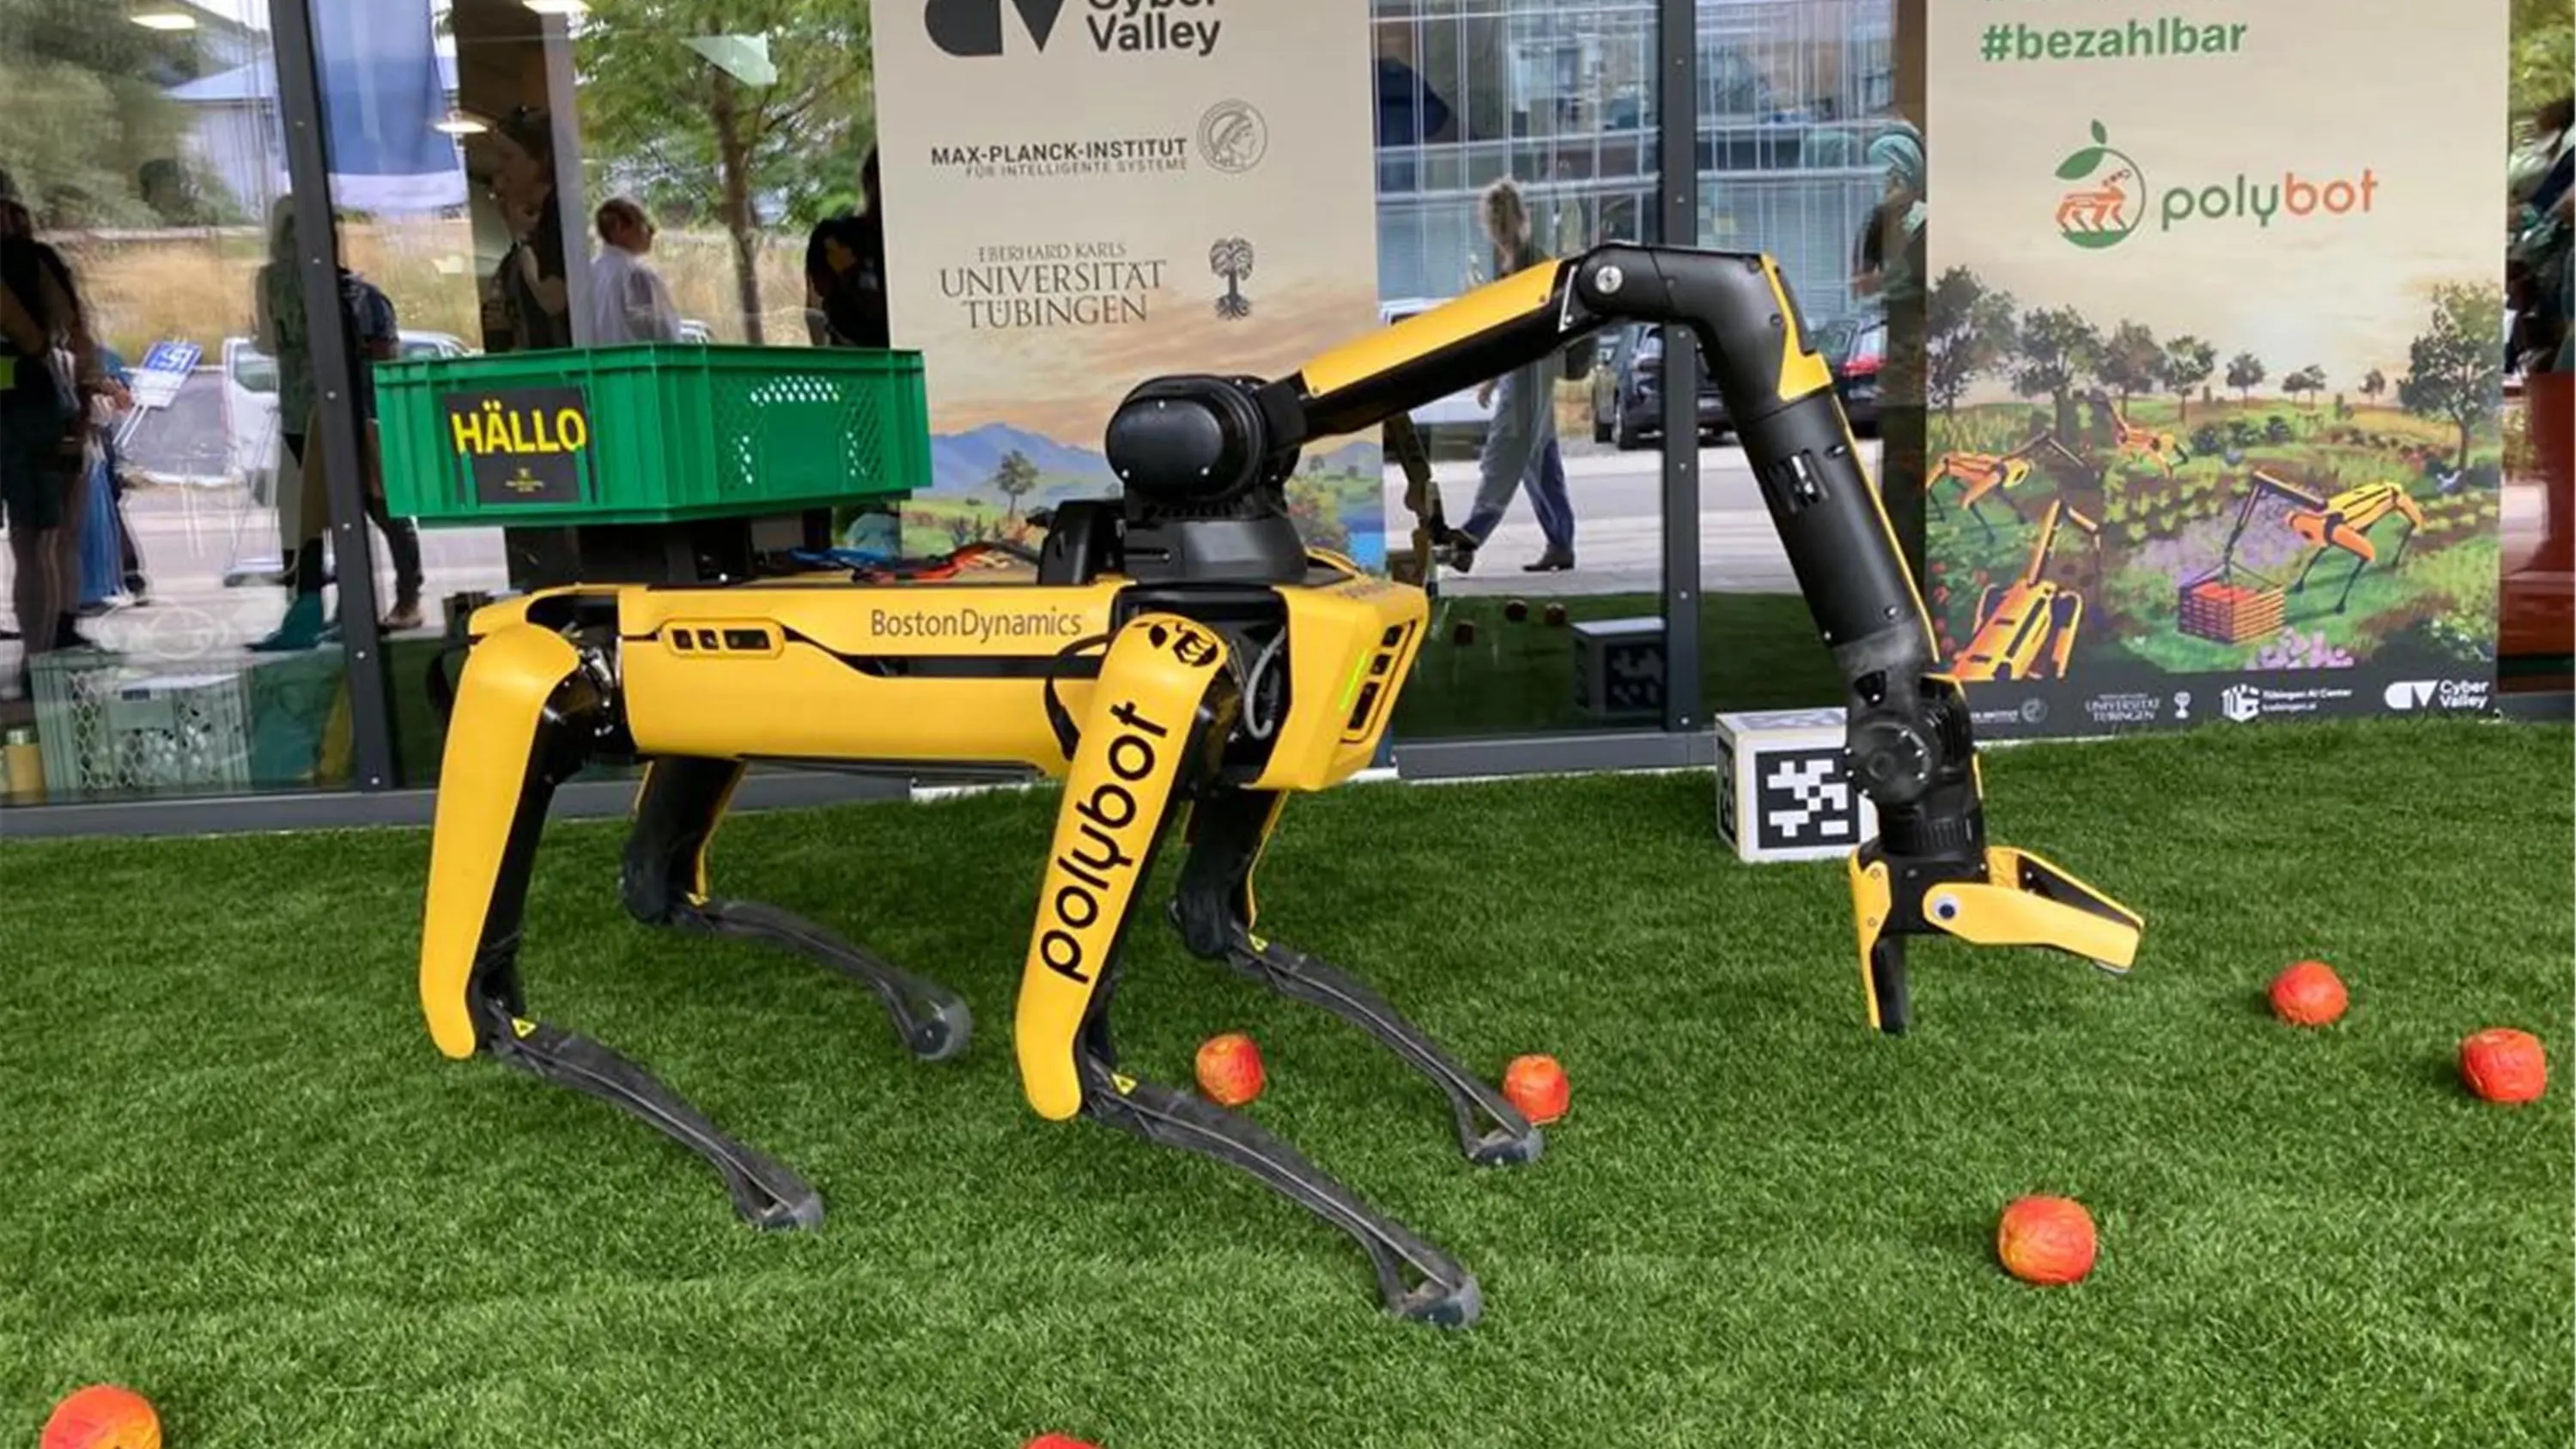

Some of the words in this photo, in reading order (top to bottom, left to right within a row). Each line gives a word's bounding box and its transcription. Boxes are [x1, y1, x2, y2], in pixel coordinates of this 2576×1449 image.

[1086, 12, 1221, 56] Valley
[1980, 17, 2247, 61] #bezahlbar
[931, 137, 1188, 166] MAX-PLANCK-INSTITUT
[1000, 161, 1110, 176] INTELLIGENTE
[1117, 156, 1188, 173] SYSTEME
[2161, 168, 2379, 231] polybot
[978, 243, 1072, 263] EBERHARD
[1074, 241, 1127, 258] KARLS
[940, 259, 1167, 298] UNIVERSITÄT
[960, 294, 1147, 329] TÜBINGEN
[451, 399, 587, 454] HÄLLO
[2439, 679, 2489, 694] Cyber
[2439, 694, 2488, 709] Valley
[1040, 700, 1168, 983] polybot
